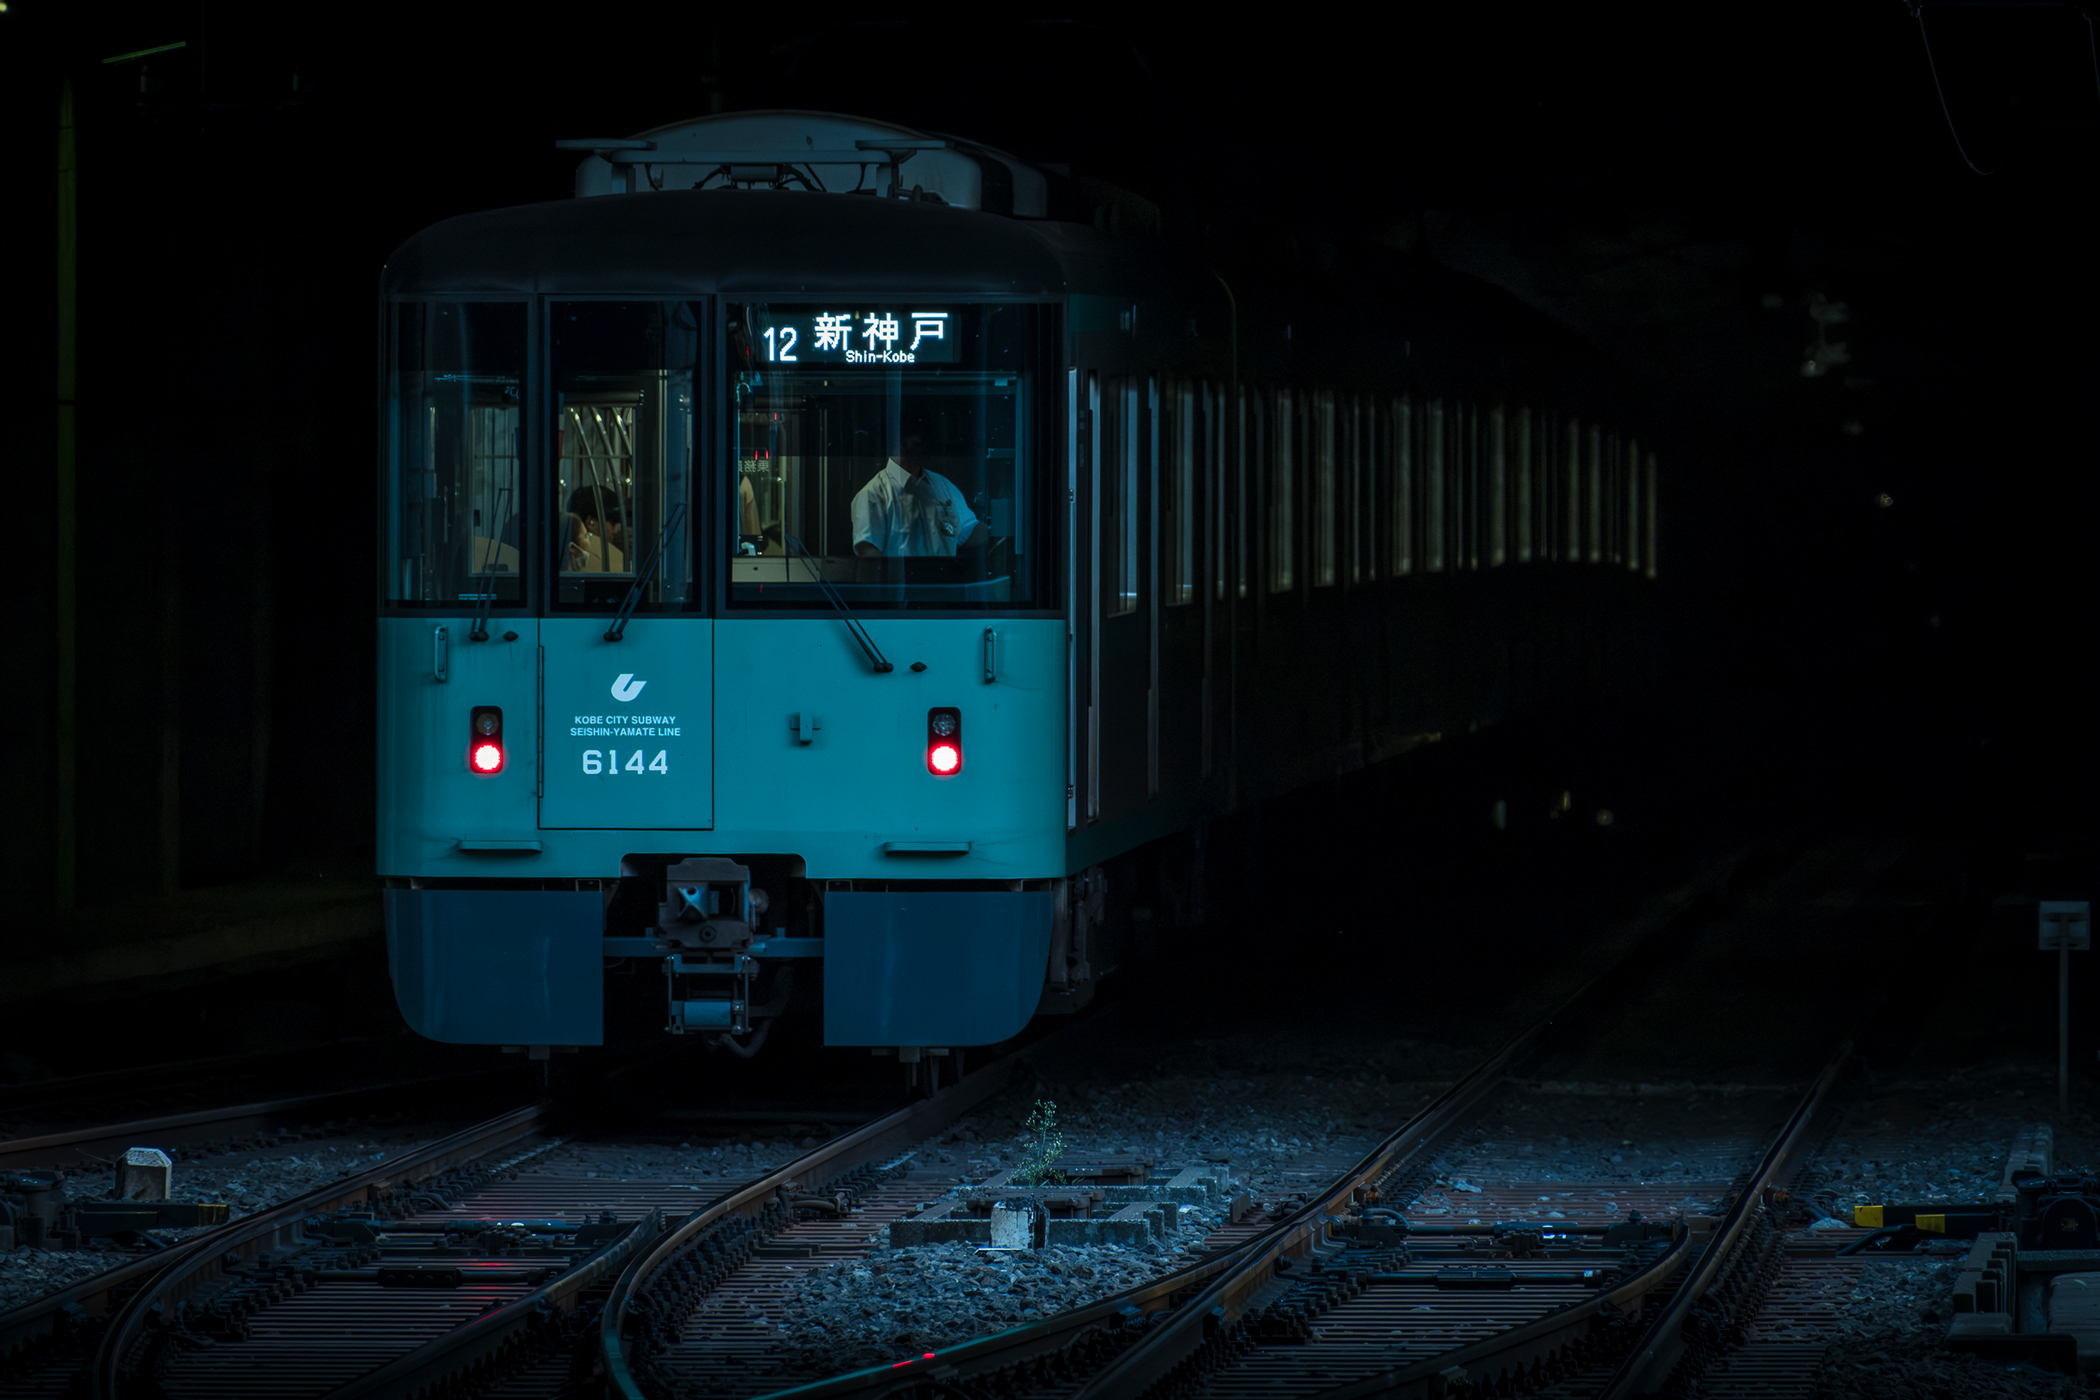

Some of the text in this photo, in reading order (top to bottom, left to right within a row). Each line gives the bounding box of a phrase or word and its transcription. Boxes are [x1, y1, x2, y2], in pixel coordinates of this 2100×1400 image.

[813, 311, 949, 351] 新神戸
[762, 326, 798, 362] 12
[845, 350, 916, 364] Shin-Kobe
[574, 715, 676, 725] KOBE CITY SUBWAY
[570, 727, 681, 737] SEISHIN-YAMATE LINE
[582, 749, 668, 775] 6144
